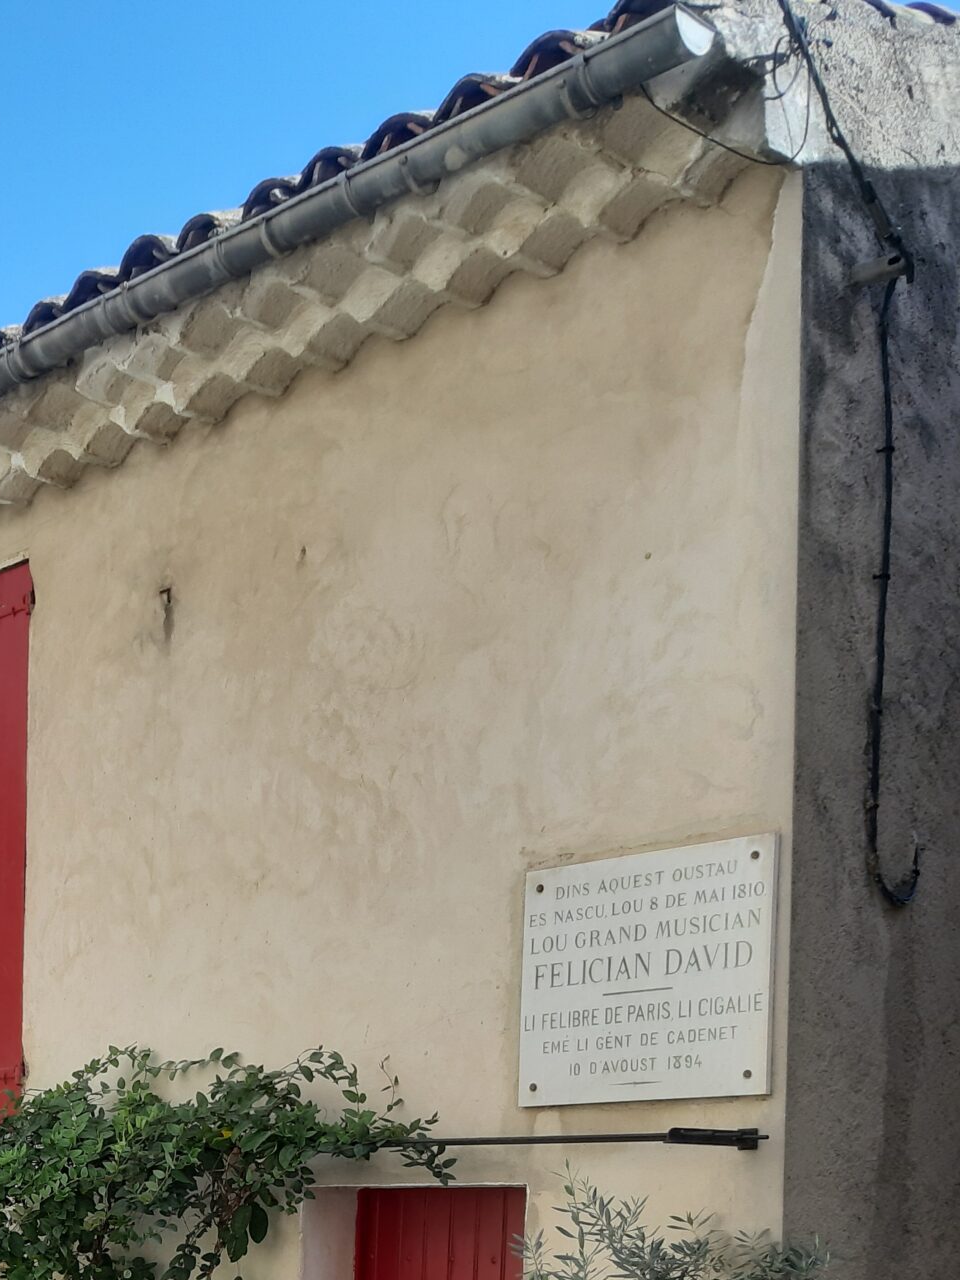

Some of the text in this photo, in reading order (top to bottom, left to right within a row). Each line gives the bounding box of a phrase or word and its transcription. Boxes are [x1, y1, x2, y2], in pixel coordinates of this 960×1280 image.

[556, 860, 738, 899] DINS AQUEST OUSTAU
[529, 914, 547, 928] ES
[612, 900, 643, 916] LOU
[650, 897, 658, 910] 8
[666, 893, 687, 908] DE
[694, 887, 725, 905] MAI
[530, 908, 761, 955] LOU GRAND MUSICIAN
[534, 941, 753, 990] FELICIAN DAVID
[524, 1015, 535, 1032] LI
[542, 1009, 599, 1030] FELIBRE
[604, 1006, 623, 1024] DE
[679, 1000, 692, 1018] LI
[577, 1039, 588, 1051] LI
[640, 1032, 658, 1046] DE
[667, 1026, 738, 1044] CADENET
[569, 1064, 580, 1076] 10
[667, 1055, 702, 1069] 1894
